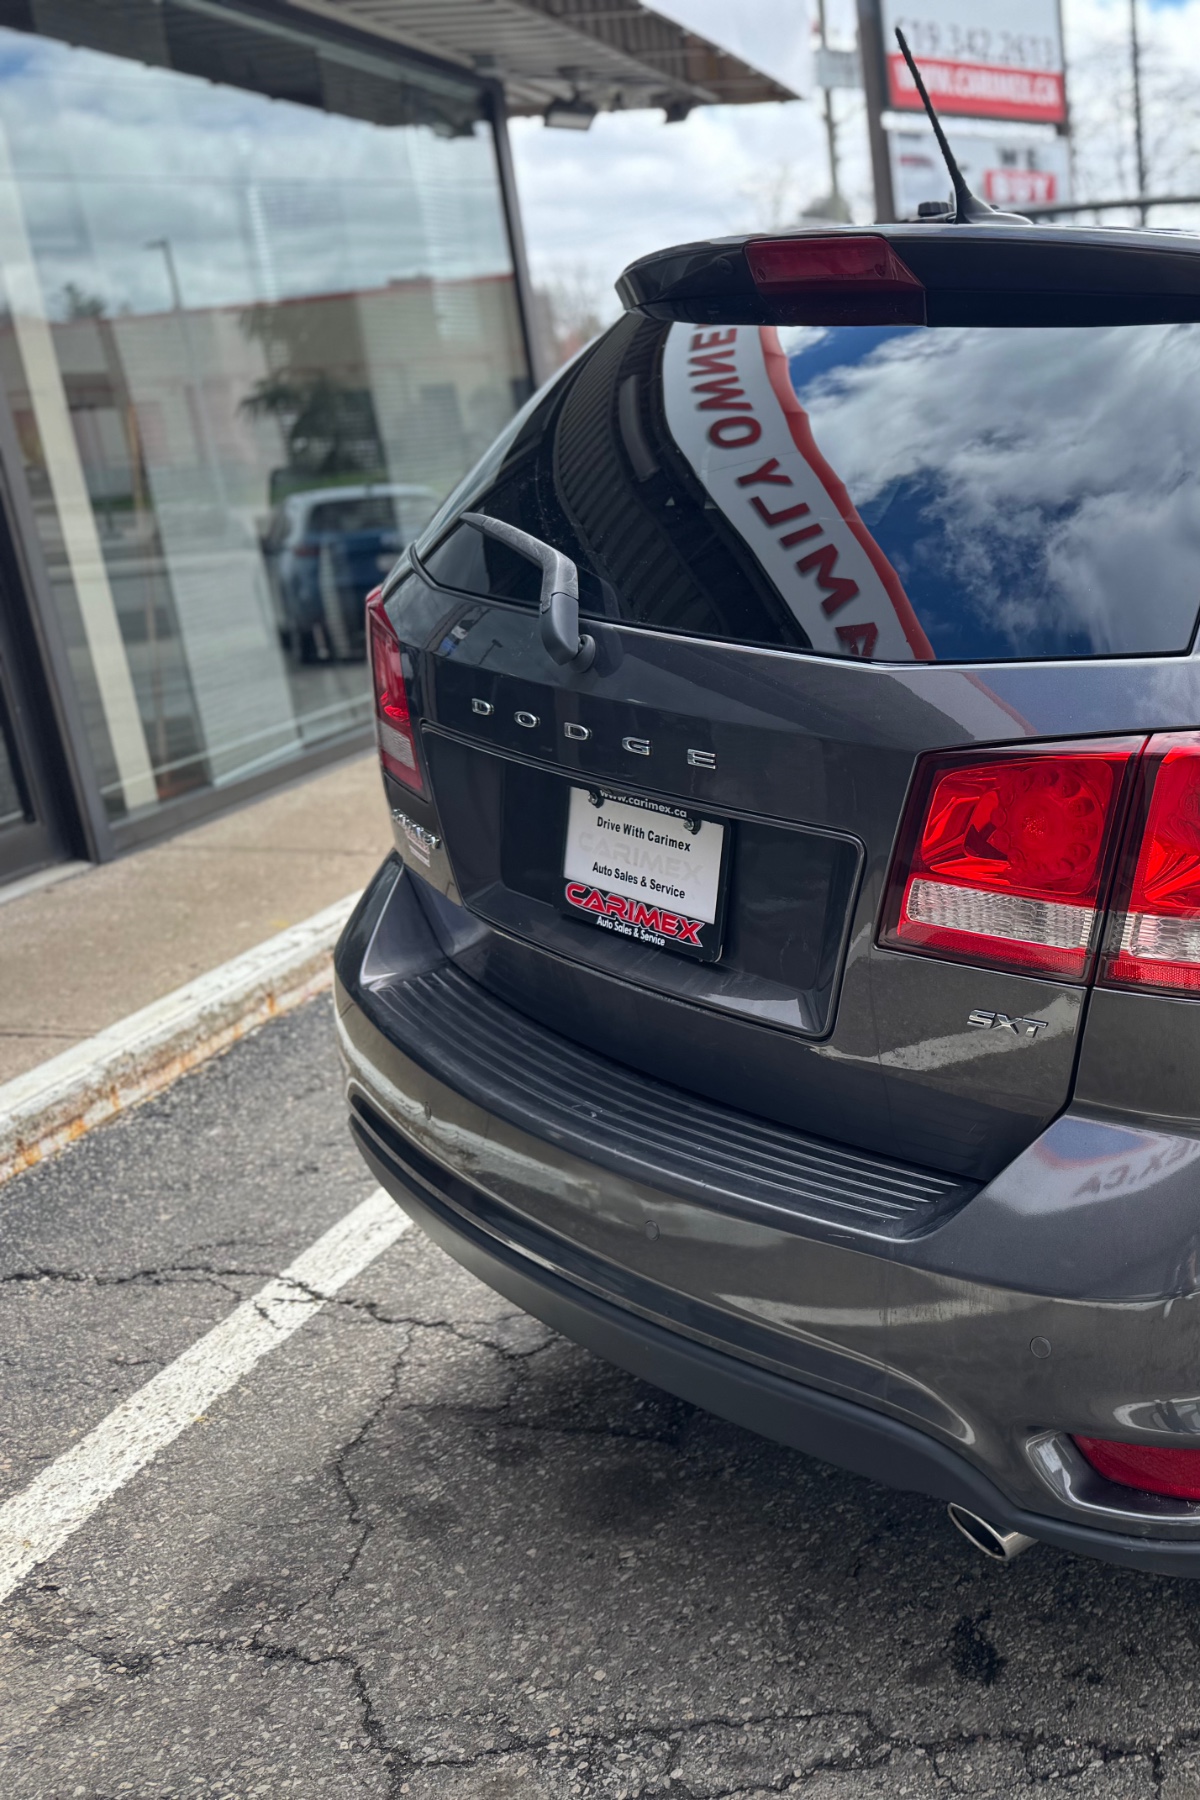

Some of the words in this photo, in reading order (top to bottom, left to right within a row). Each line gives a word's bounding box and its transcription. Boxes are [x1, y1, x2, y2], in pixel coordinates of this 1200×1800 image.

[472, 698, 716, 769] DODGE
[597, 816, 621, 833] Drive
[623, 823, 645, 840] With
[647, 830, 691, 852] Carimex
[592, 861, 612, 877] Auto
[614, 868, 638, 885] Sales
[640, 876, 647, 887] &
[649, 879, 686, 899] Service
[565, 881, 704, 946] CARIMEX
[597, 915, 613, 930] Auto
[614, 921, 632, 936] Sales
[633, 928, 639, 938] &
[640, 929, 666, 947] Service
[966, 1009, 1048, 1038] SXT
